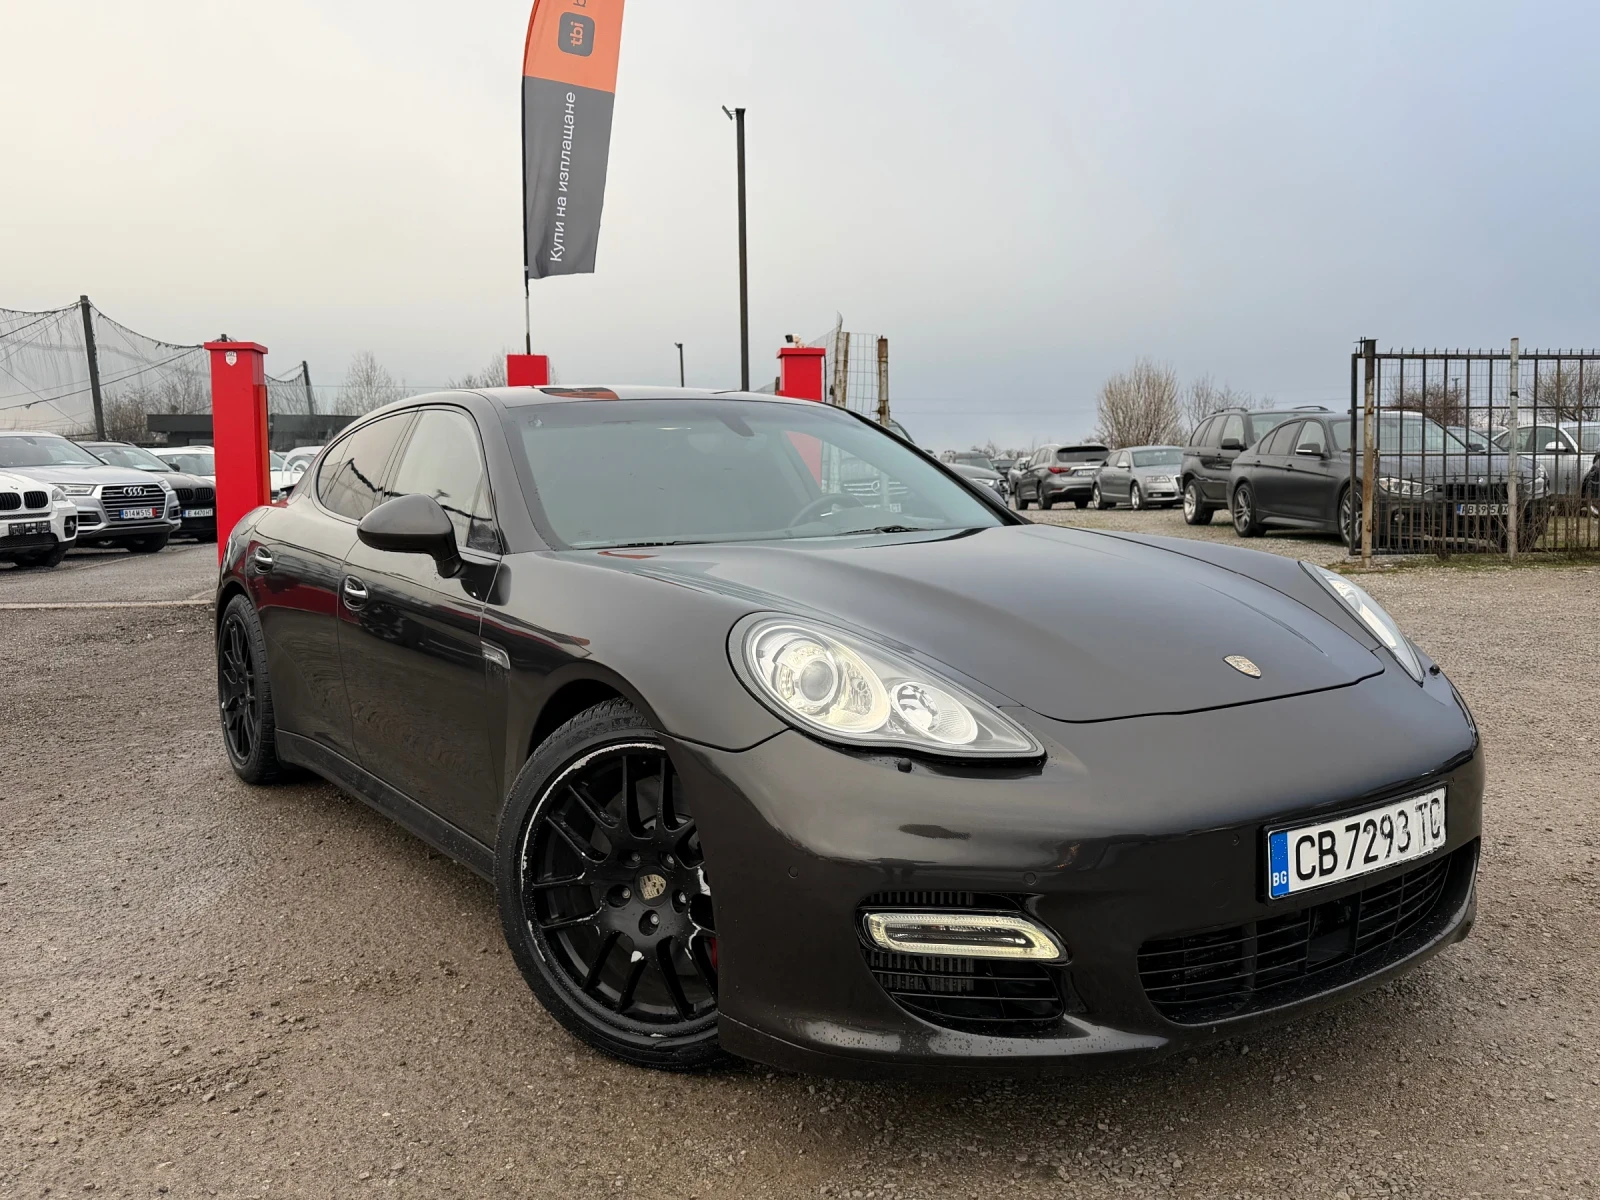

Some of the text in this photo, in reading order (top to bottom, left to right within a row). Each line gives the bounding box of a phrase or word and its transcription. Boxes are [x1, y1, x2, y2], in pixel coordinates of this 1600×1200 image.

[570, 21, 584, 46] tbi
[550, 92, 576, 262] Купи на изплащане
[1295, 797, 1441, 881] CB 7293 TC
[1272, 870, 1287, 887] BG
